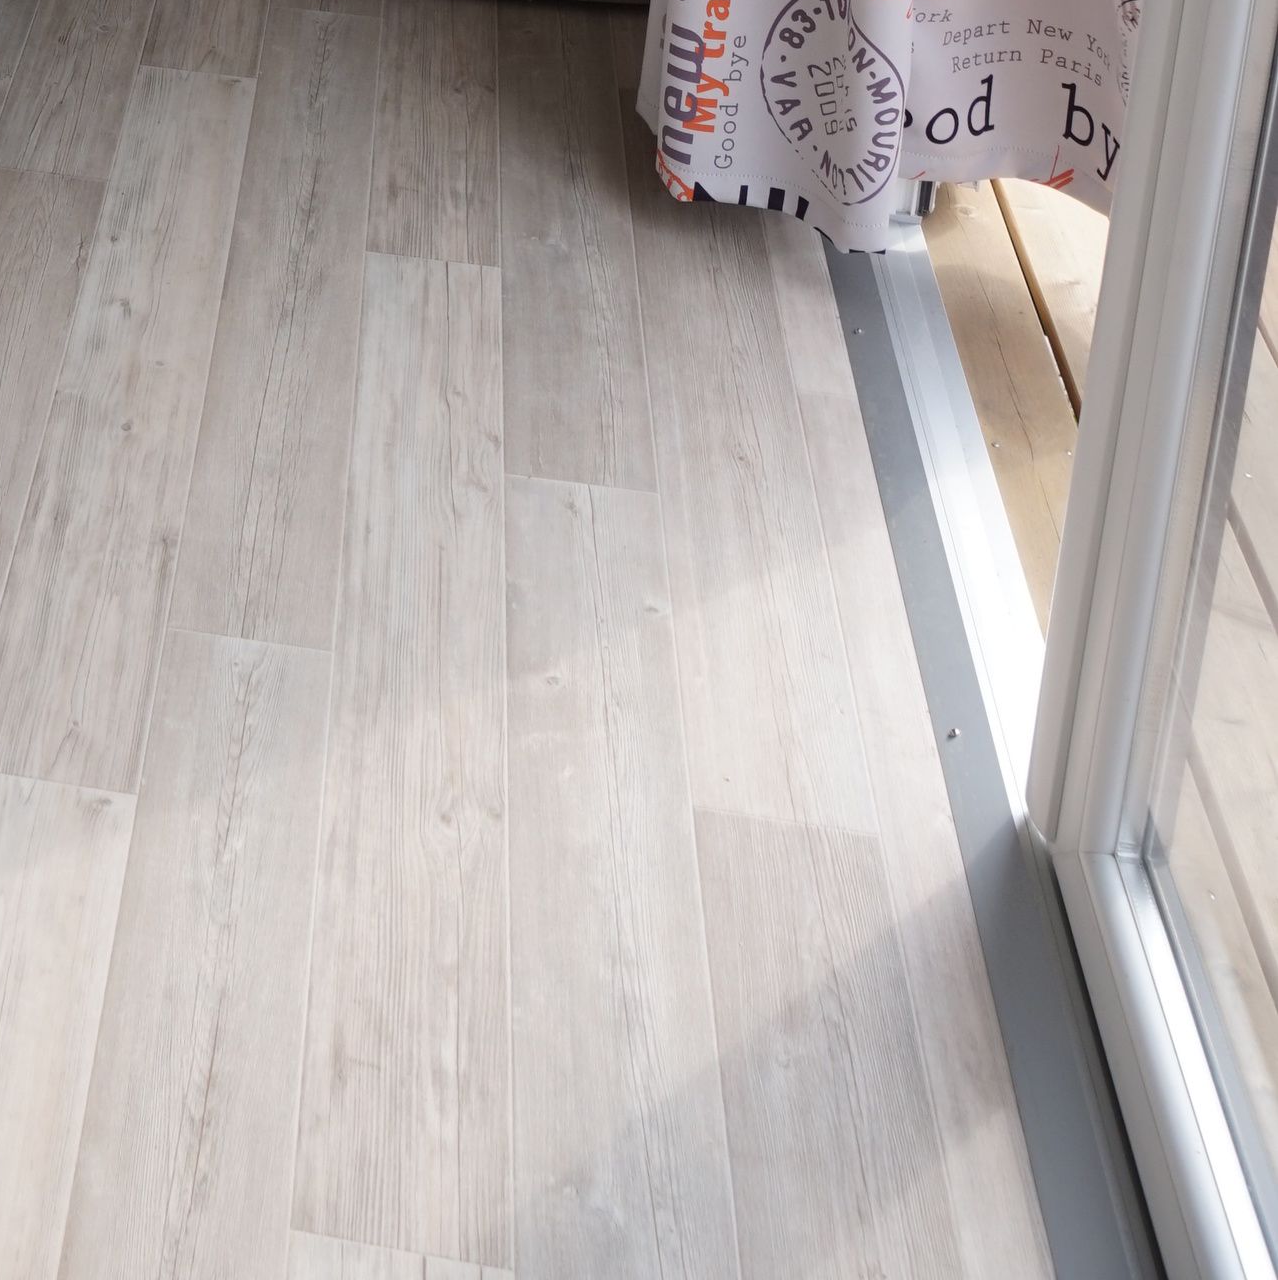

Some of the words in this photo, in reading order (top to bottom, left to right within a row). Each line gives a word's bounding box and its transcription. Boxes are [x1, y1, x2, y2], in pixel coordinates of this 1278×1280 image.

[915, 10, 954, 24] ork
[942, 19, 1011, 47] Depart
[1026, 18, 1074, 42] New
[722, 34, 749, 83] bye
[951, 48, 1023, 74] Return
[1039, 48, 1103, 88] Paris
[713, 101, 739, 170] Good
